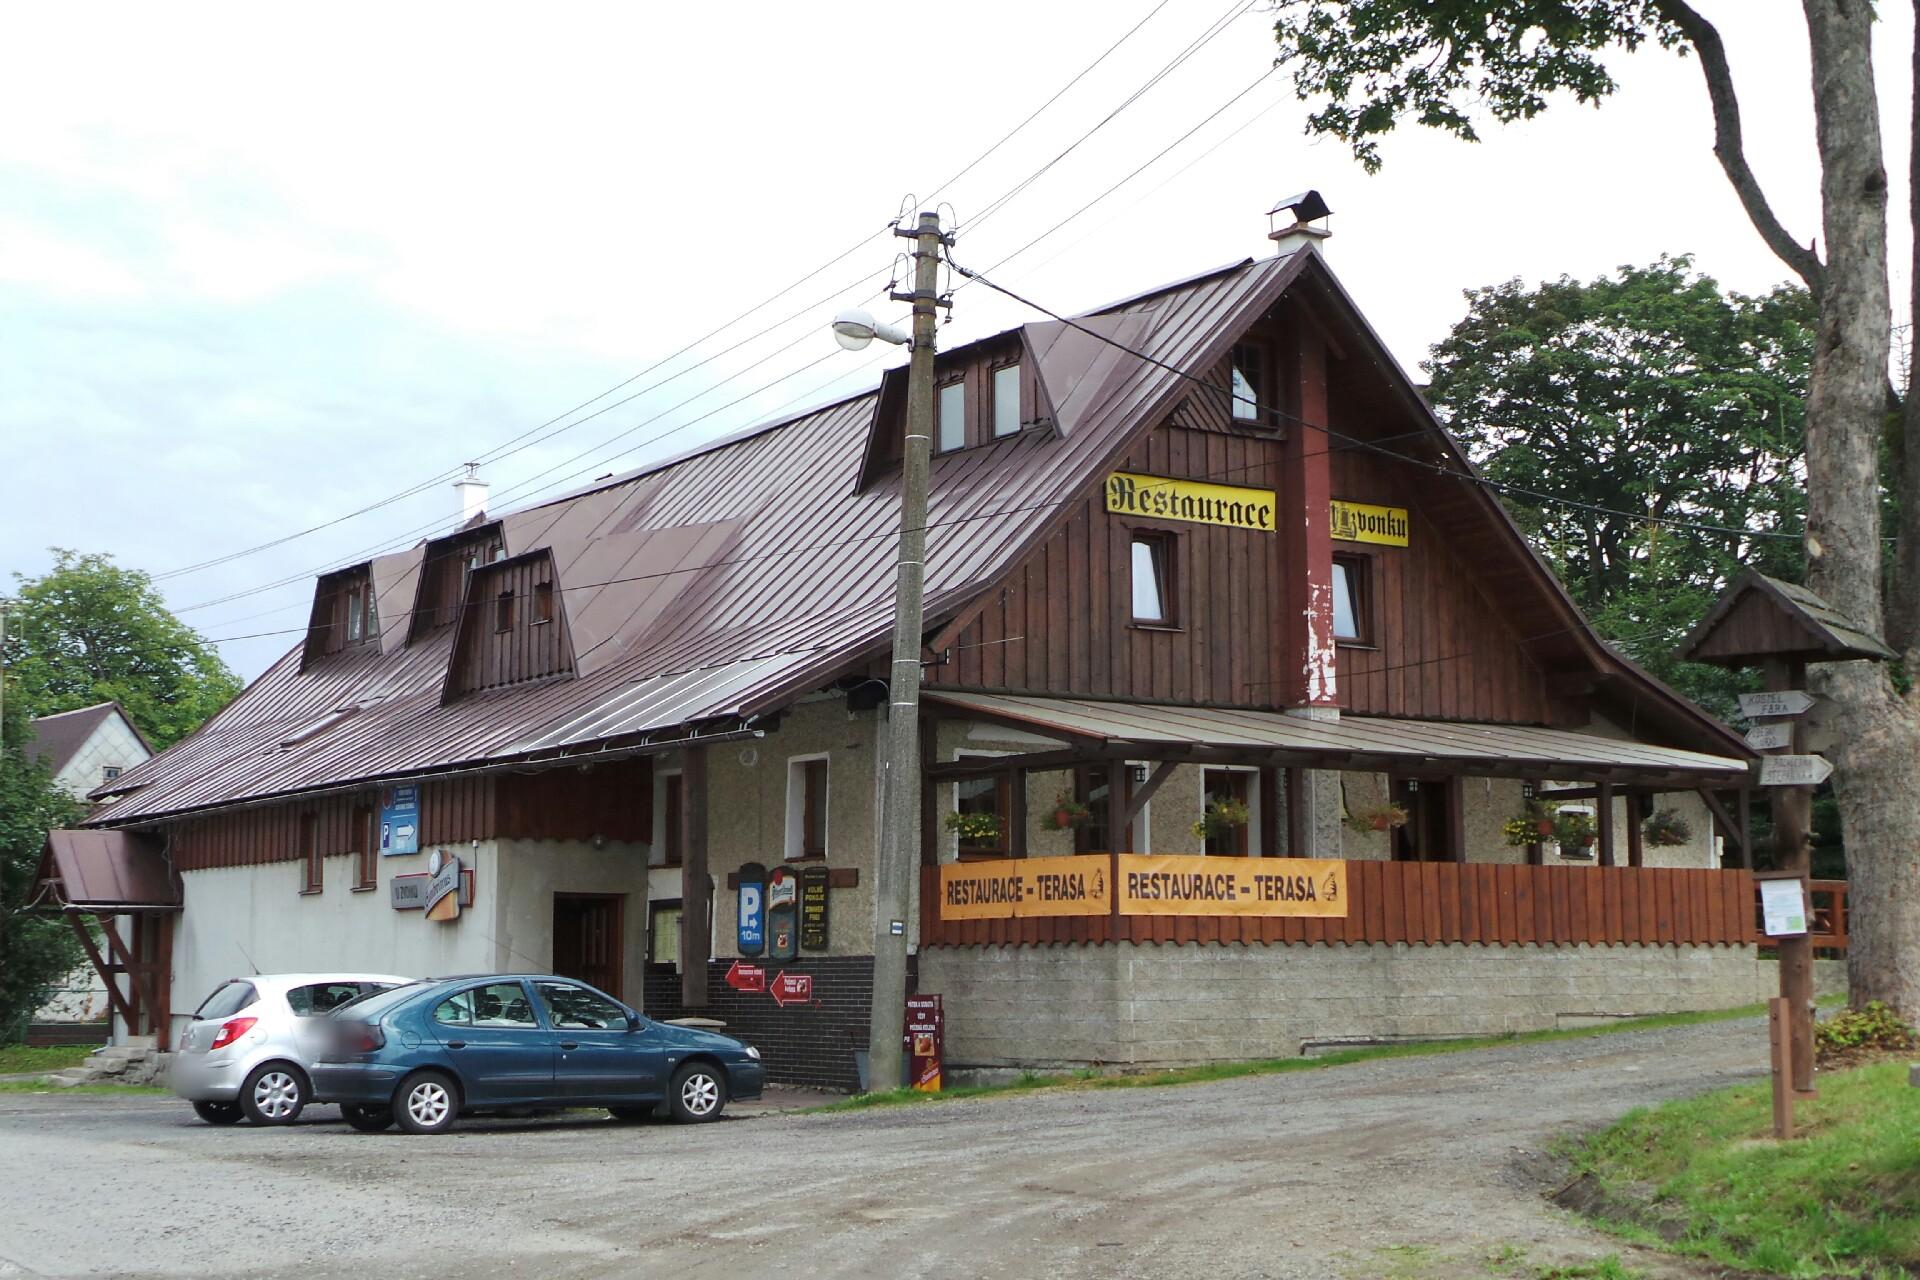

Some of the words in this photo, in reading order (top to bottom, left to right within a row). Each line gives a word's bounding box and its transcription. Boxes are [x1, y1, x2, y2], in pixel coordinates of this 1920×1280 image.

[1110, 476, 1271, 529] Restaurace
[947, 876, 1024, 906] RESTAURACE
[1037, 873, 1086, 901] TERASA
[1128, 872, 1236, 901] RESTAURACE
[1254, 875, 1317, 902] TERASA
[741, 887, 760, 927] P
